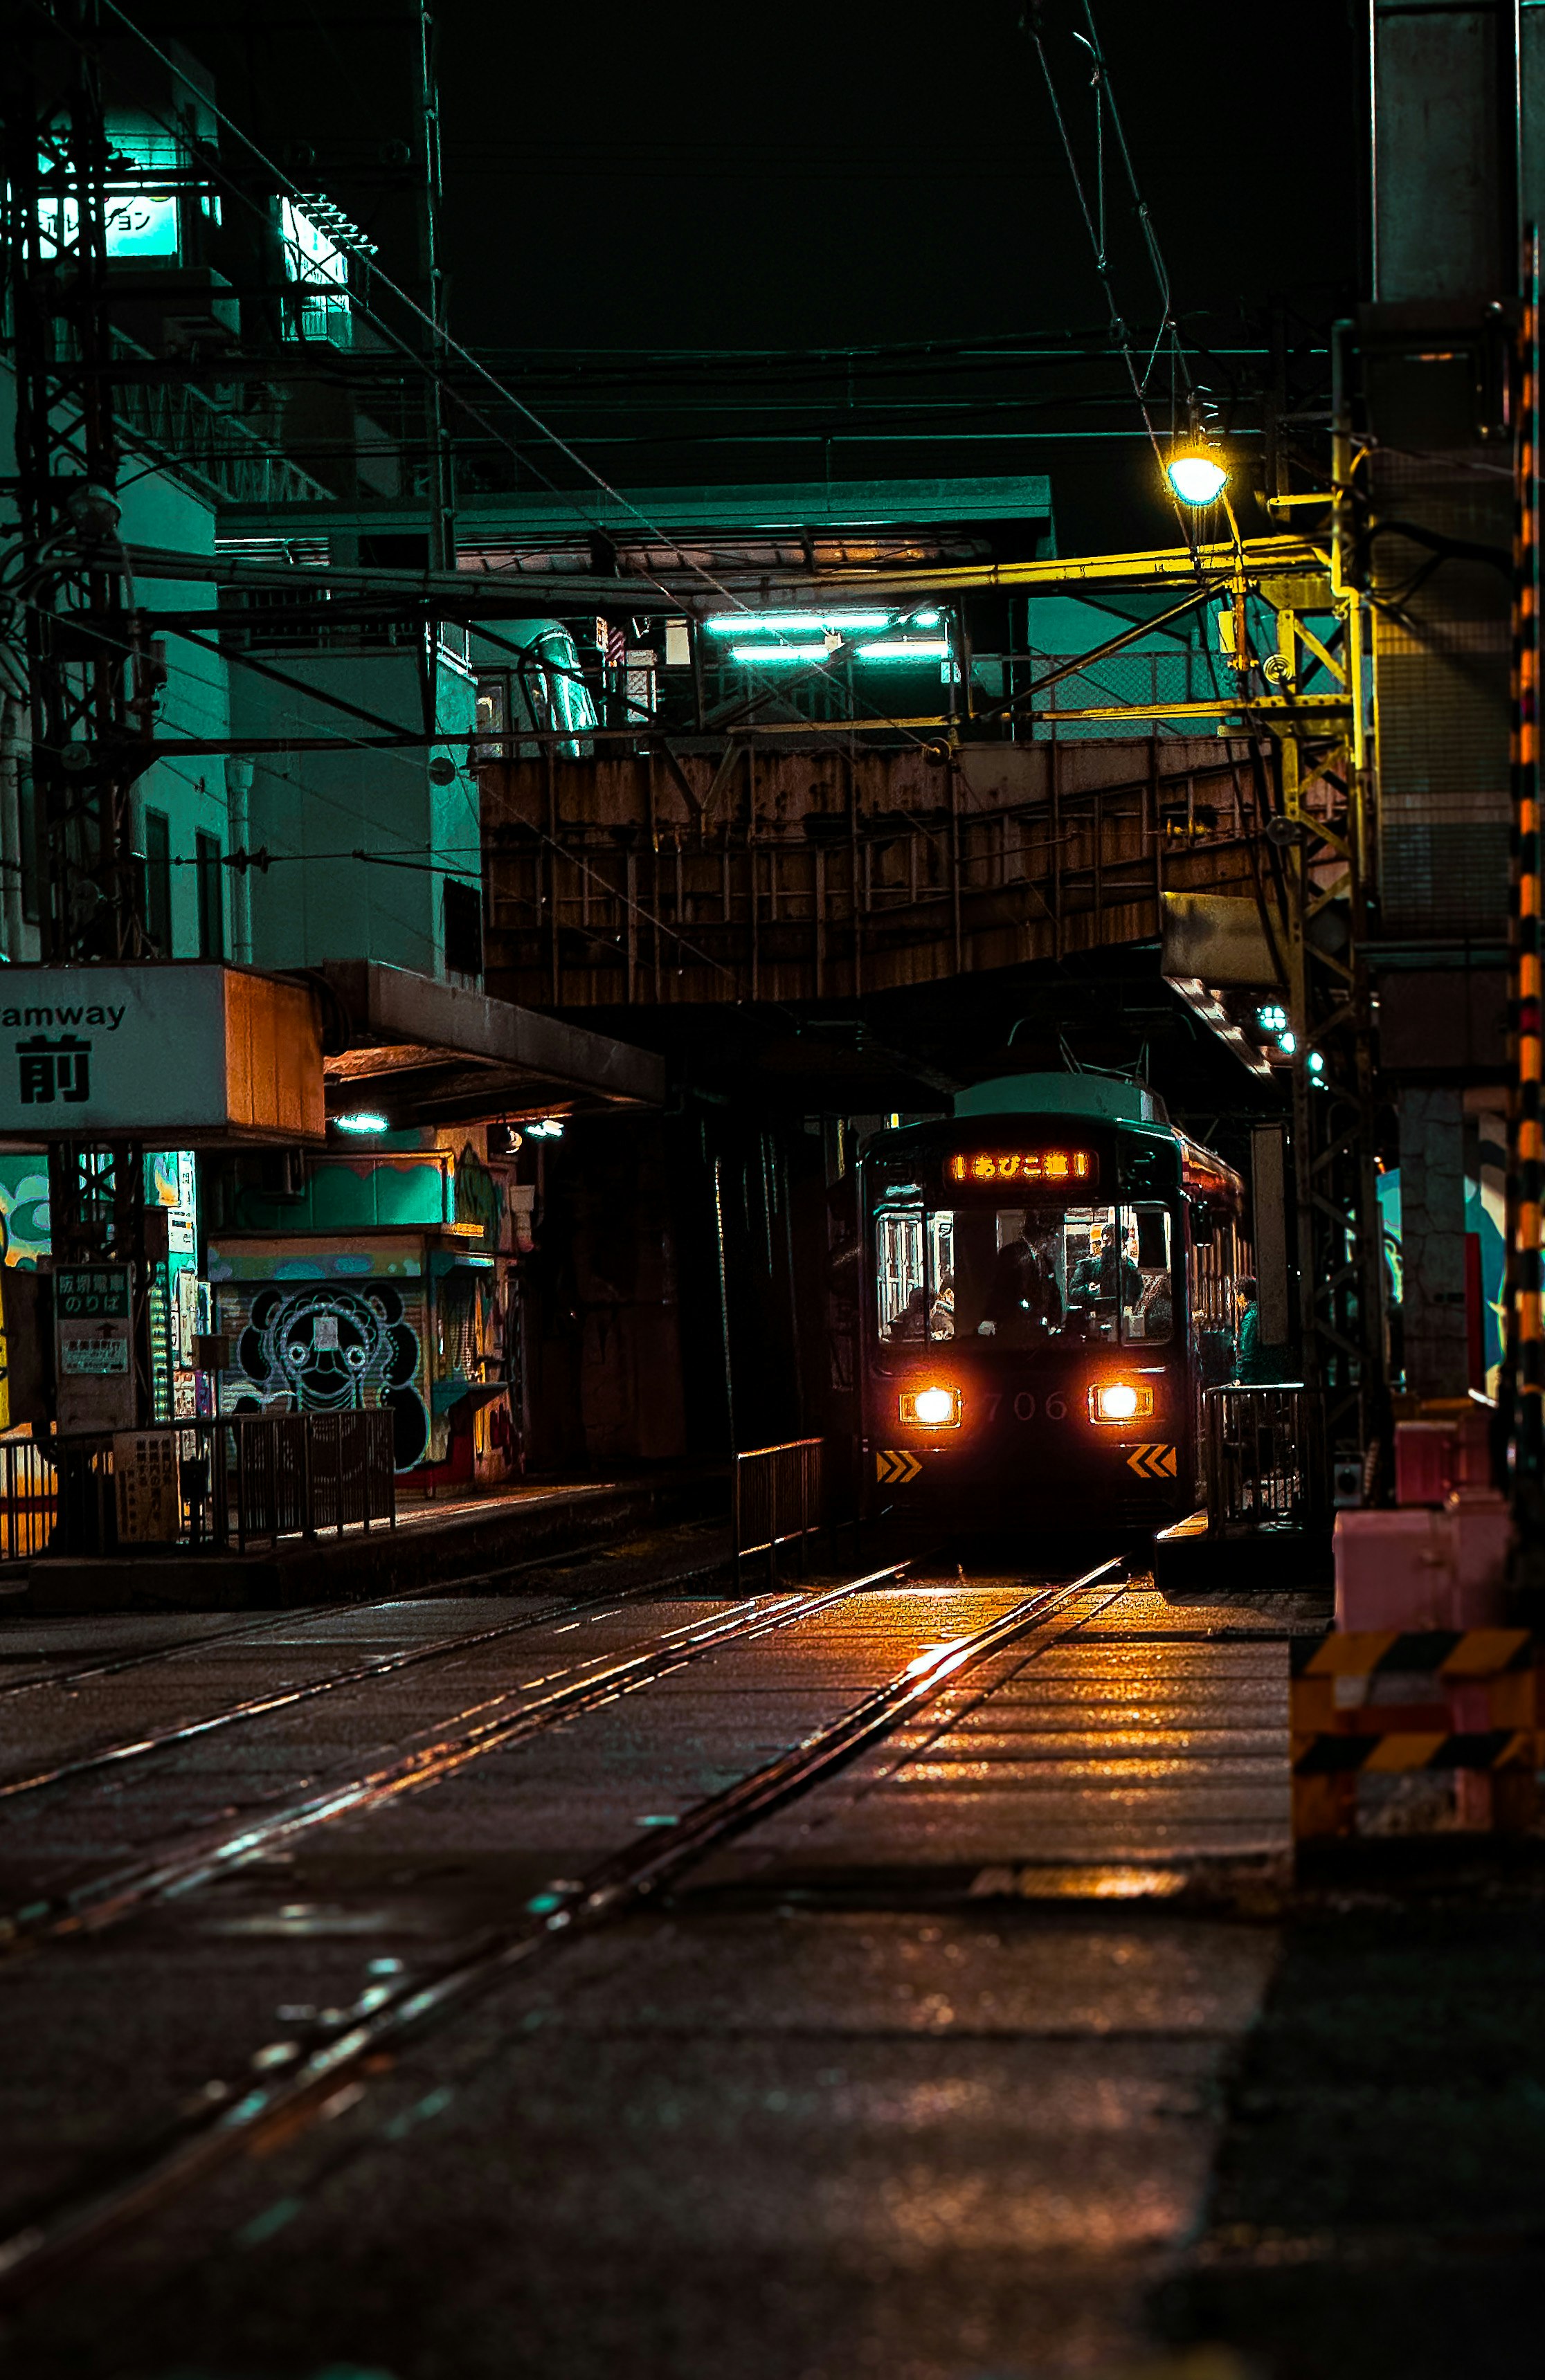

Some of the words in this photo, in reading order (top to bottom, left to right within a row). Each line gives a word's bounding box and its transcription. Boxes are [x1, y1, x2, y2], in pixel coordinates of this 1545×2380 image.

[15, 1035, 92, 1104] 前
[65, 1296, 120, 1312] のりば
[985, 1391, 1068, 1422] 706
